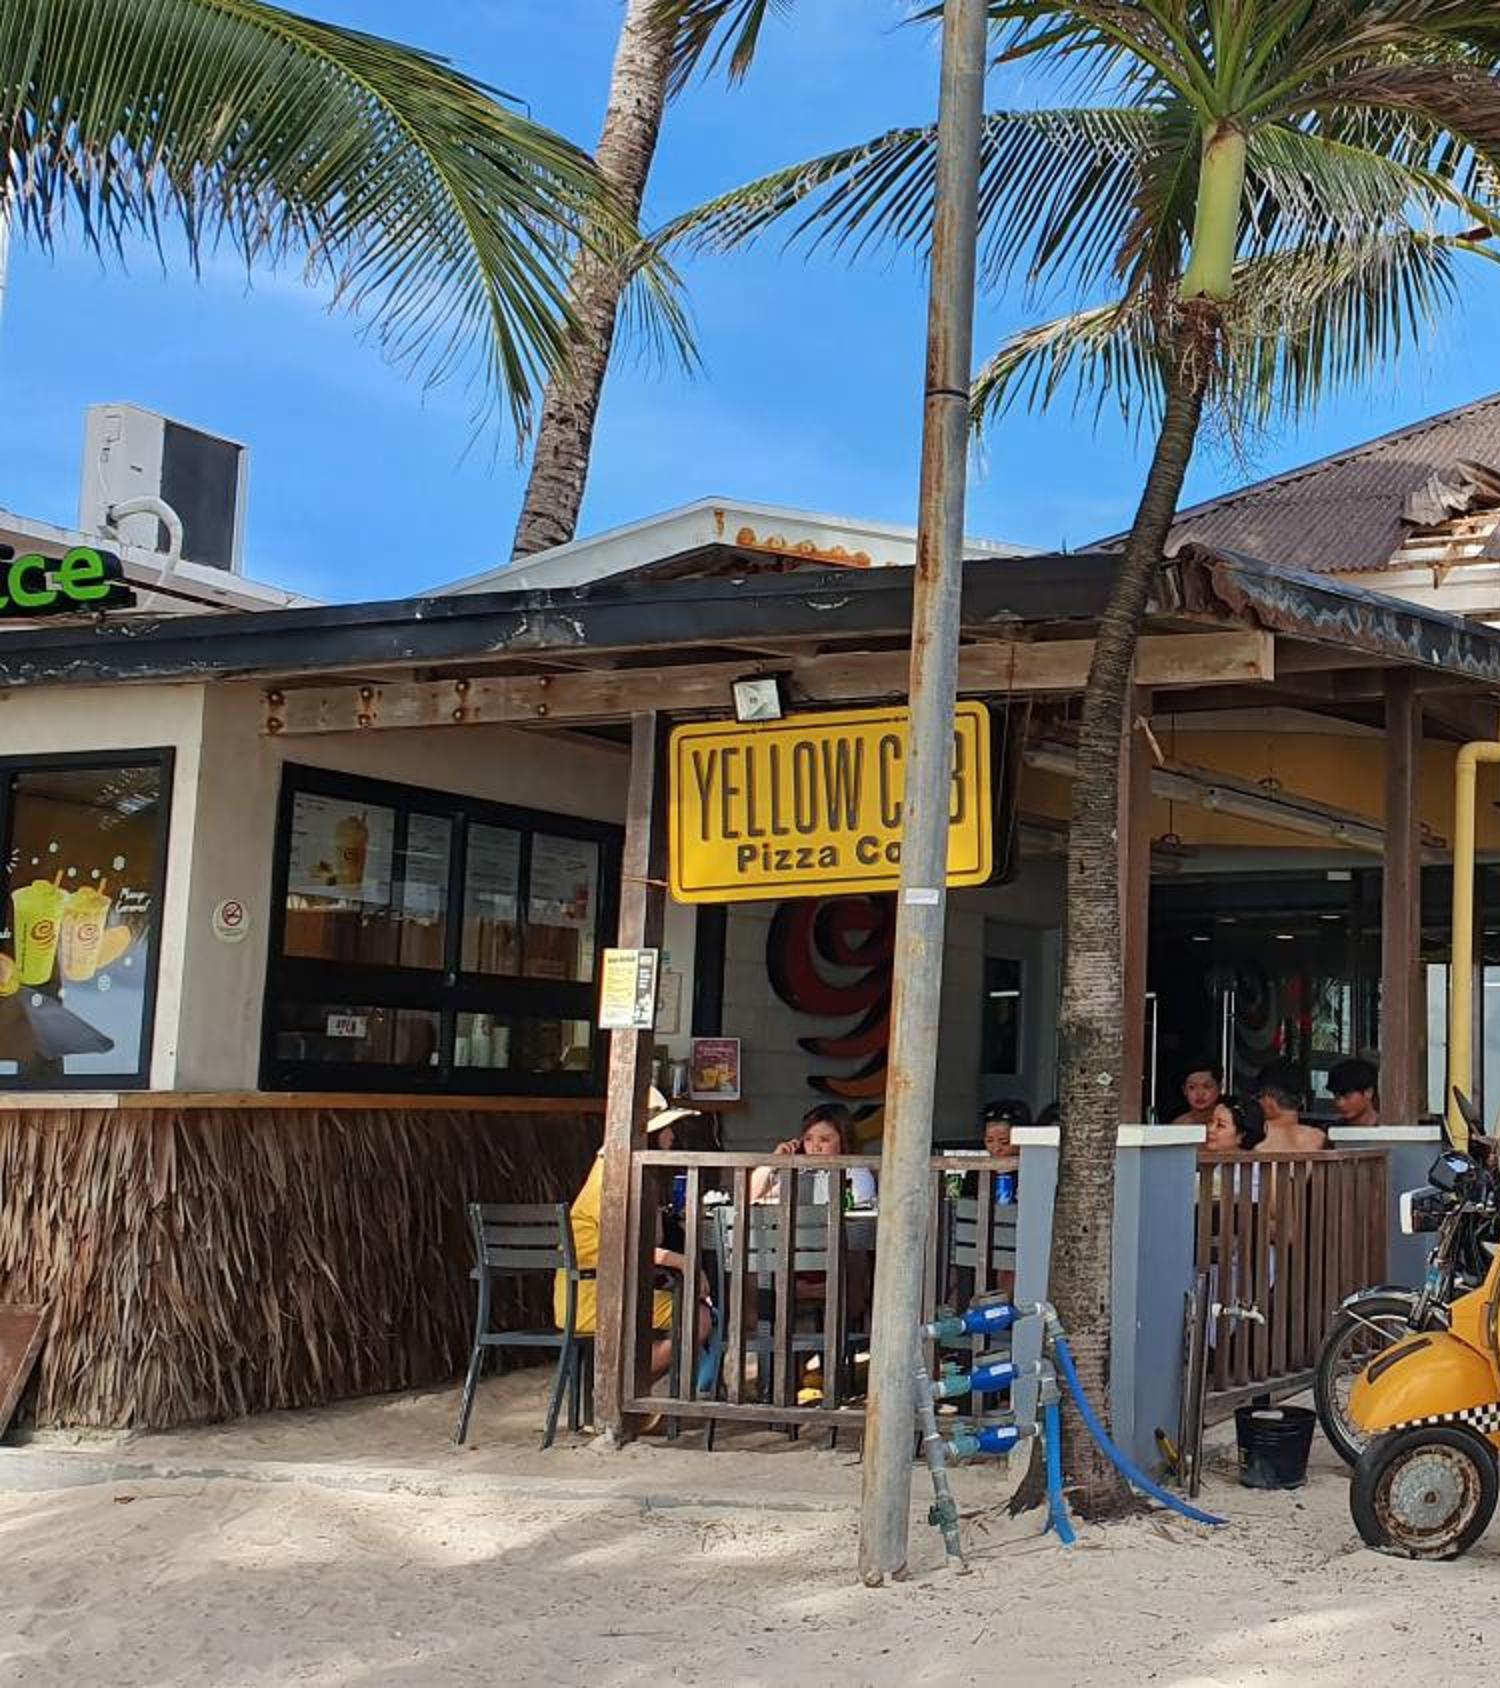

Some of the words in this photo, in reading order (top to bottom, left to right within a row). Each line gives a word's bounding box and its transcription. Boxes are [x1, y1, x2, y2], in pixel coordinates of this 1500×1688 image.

[0, 546, 110, 607] ce
[692, 736, 865, 841] YELLOW
[880, 730, 966, 829] CB
[737, 843, 840, 873] Pizza
